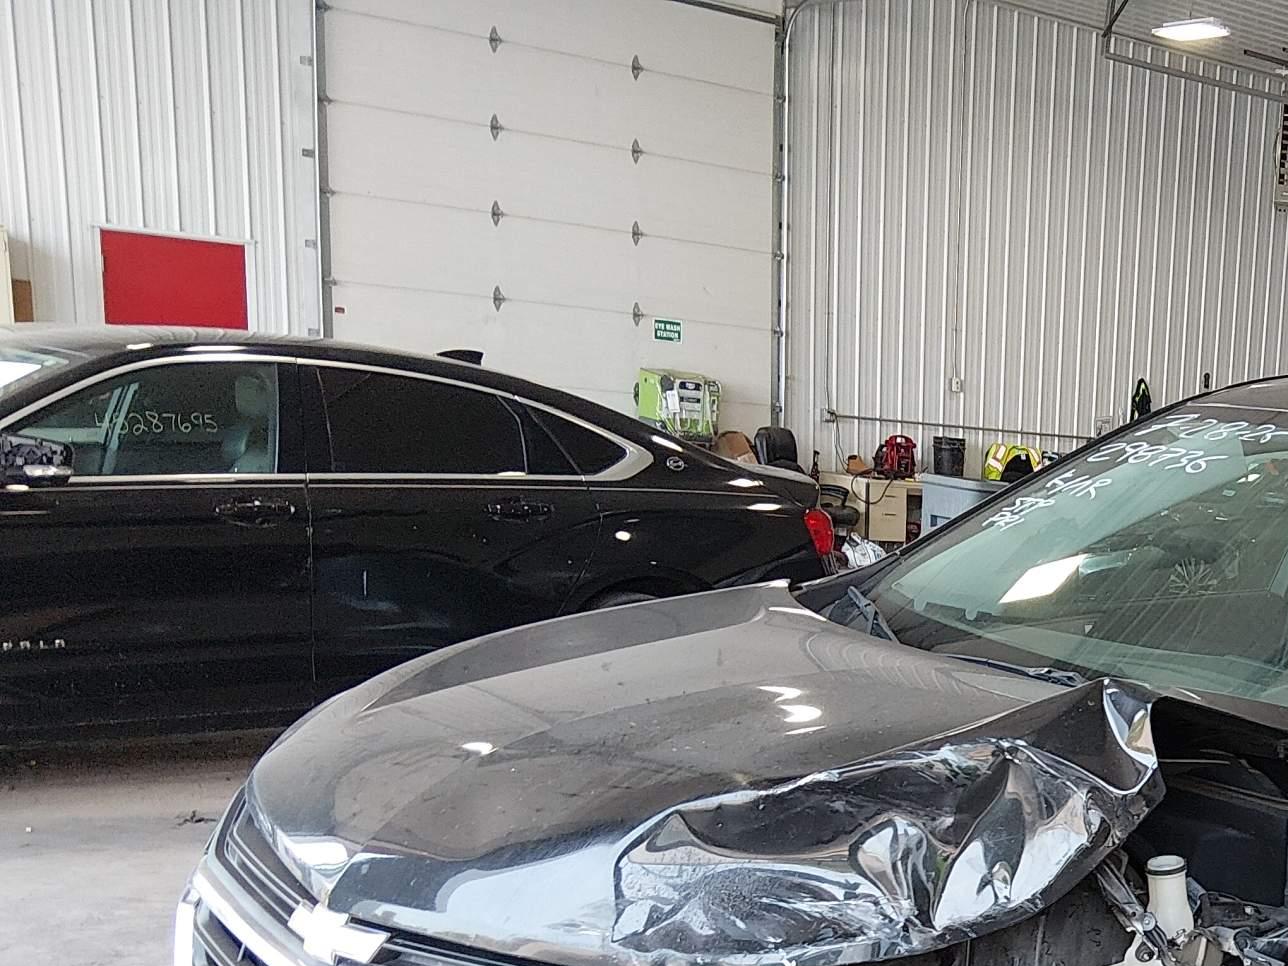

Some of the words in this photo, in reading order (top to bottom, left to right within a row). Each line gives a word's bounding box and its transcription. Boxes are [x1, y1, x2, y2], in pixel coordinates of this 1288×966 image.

[666, 323, 680, 331] WASH
[657, 330, 679, 339] STATION
[1086, 441, 1229, 473] 298736
